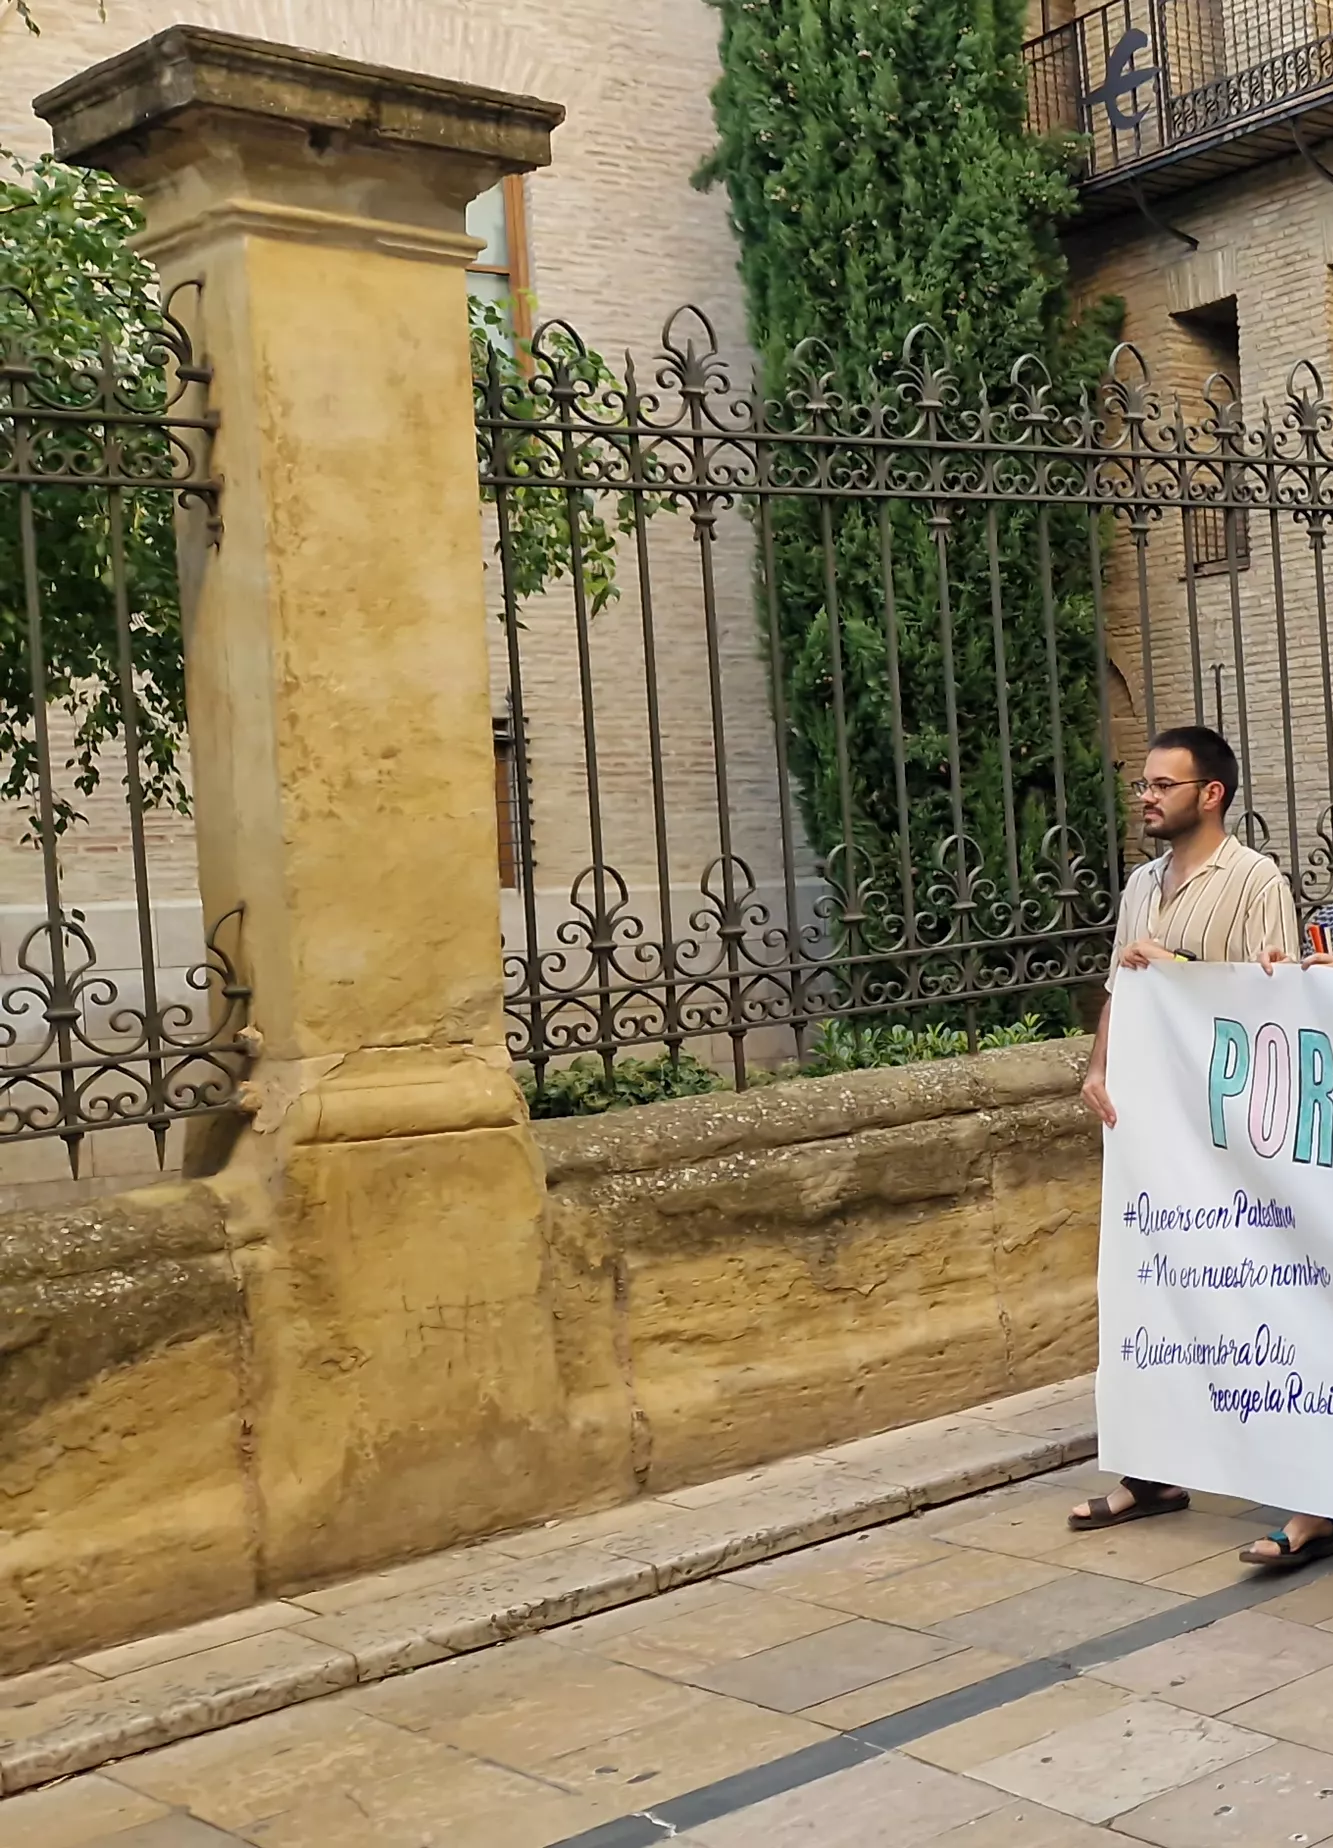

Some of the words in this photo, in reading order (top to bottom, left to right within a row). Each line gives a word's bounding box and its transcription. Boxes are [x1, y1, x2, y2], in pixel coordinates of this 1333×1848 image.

[1195, 1206, 1233, 1230] con
[1233, 1189, 1296, 1229] Palestina
[1180, 1267, 1201, 1288] en
[1201, 1257, 1268, 1289] nuestro
[1270, 1254, 1331, 1288] nombre
[1254, 1323, 1296, 1367] Odio
